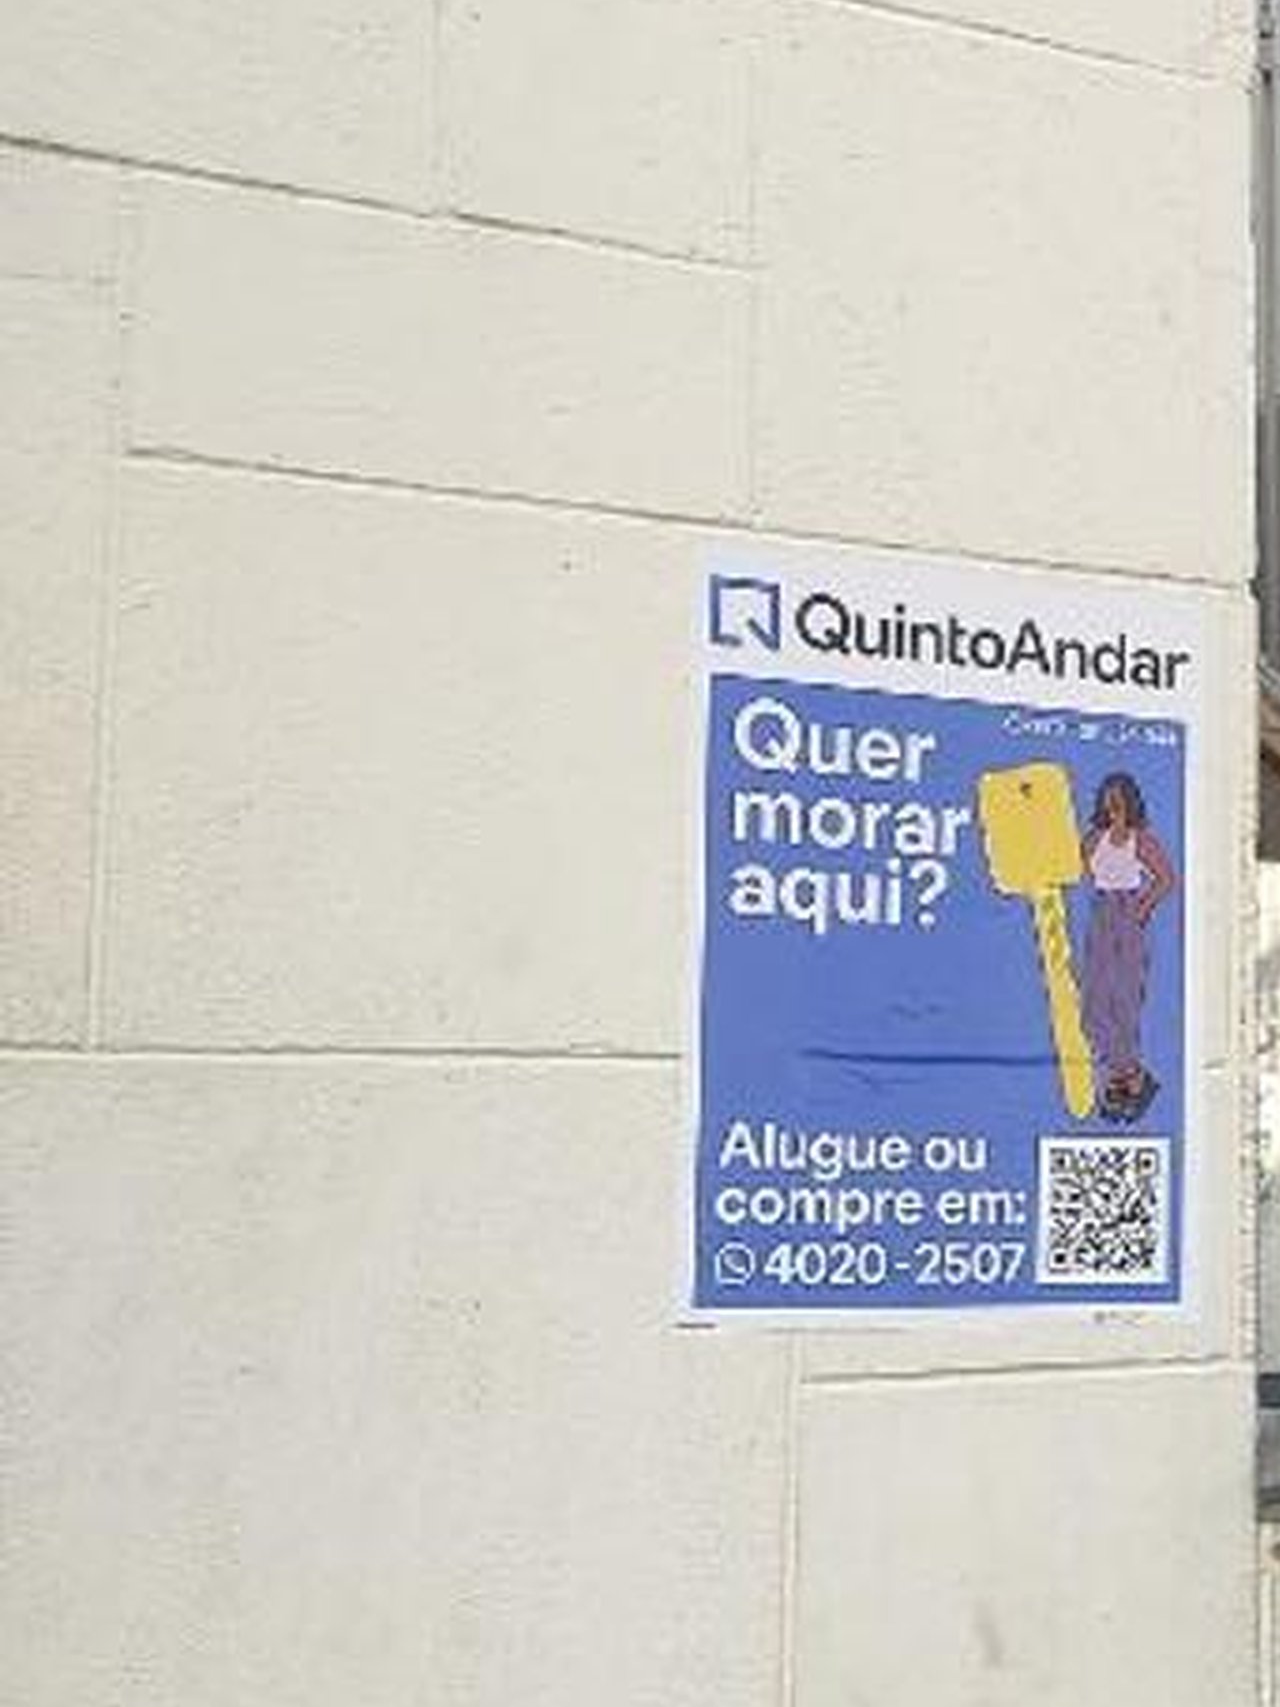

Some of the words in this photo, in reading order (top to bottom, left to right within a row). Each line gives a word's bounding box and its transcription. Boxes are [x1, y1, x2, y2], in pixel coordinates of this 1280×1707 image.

[795, 593, 1190, 690] QuintoAndar
[733, 697, 938, 784] Quer
[733, 787, 972, 857] morar
[728, 859, 949, 935] aqui?
[719, 1120, 912, 1181] Alugue
[923, 1137, 988, 1171] ou
[715, 1188, 925, 1234] compre
[937, 1188, 1027, 1225] em:
